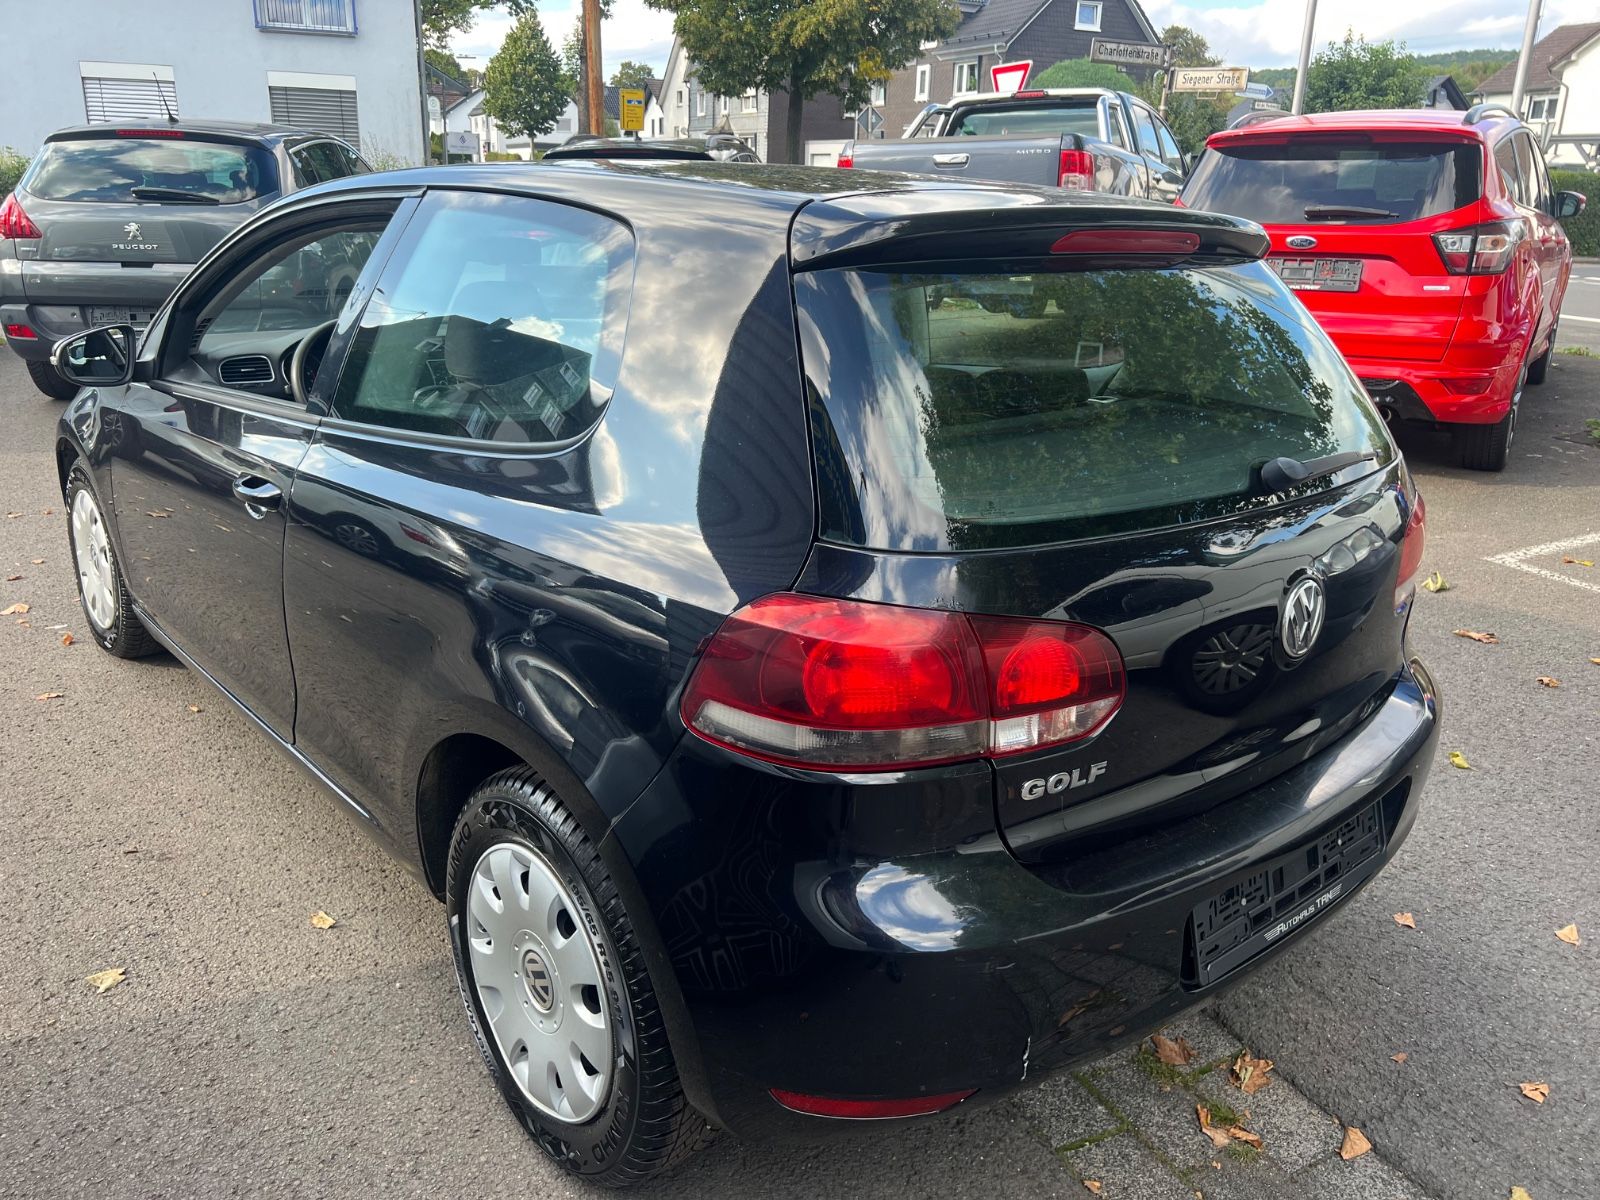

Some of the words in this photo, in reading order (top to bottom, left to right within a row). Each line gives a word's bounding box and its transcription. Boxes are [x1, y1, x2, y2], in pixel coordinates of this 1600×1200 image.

[1098, 44, 1159, 61] Charlottenstraße
[1182, 73, 1214, 86] Siegener
[1217, 72, 1241, 84] Straße
[1021, 761, 1108, 801] GOLF
[447, 821, 472, 901] KUMHO
[565, 875, 600, 937] 195/65
[597, 942, 615, 983] R15
[591, 1090, 630, 1164] KUMHO
